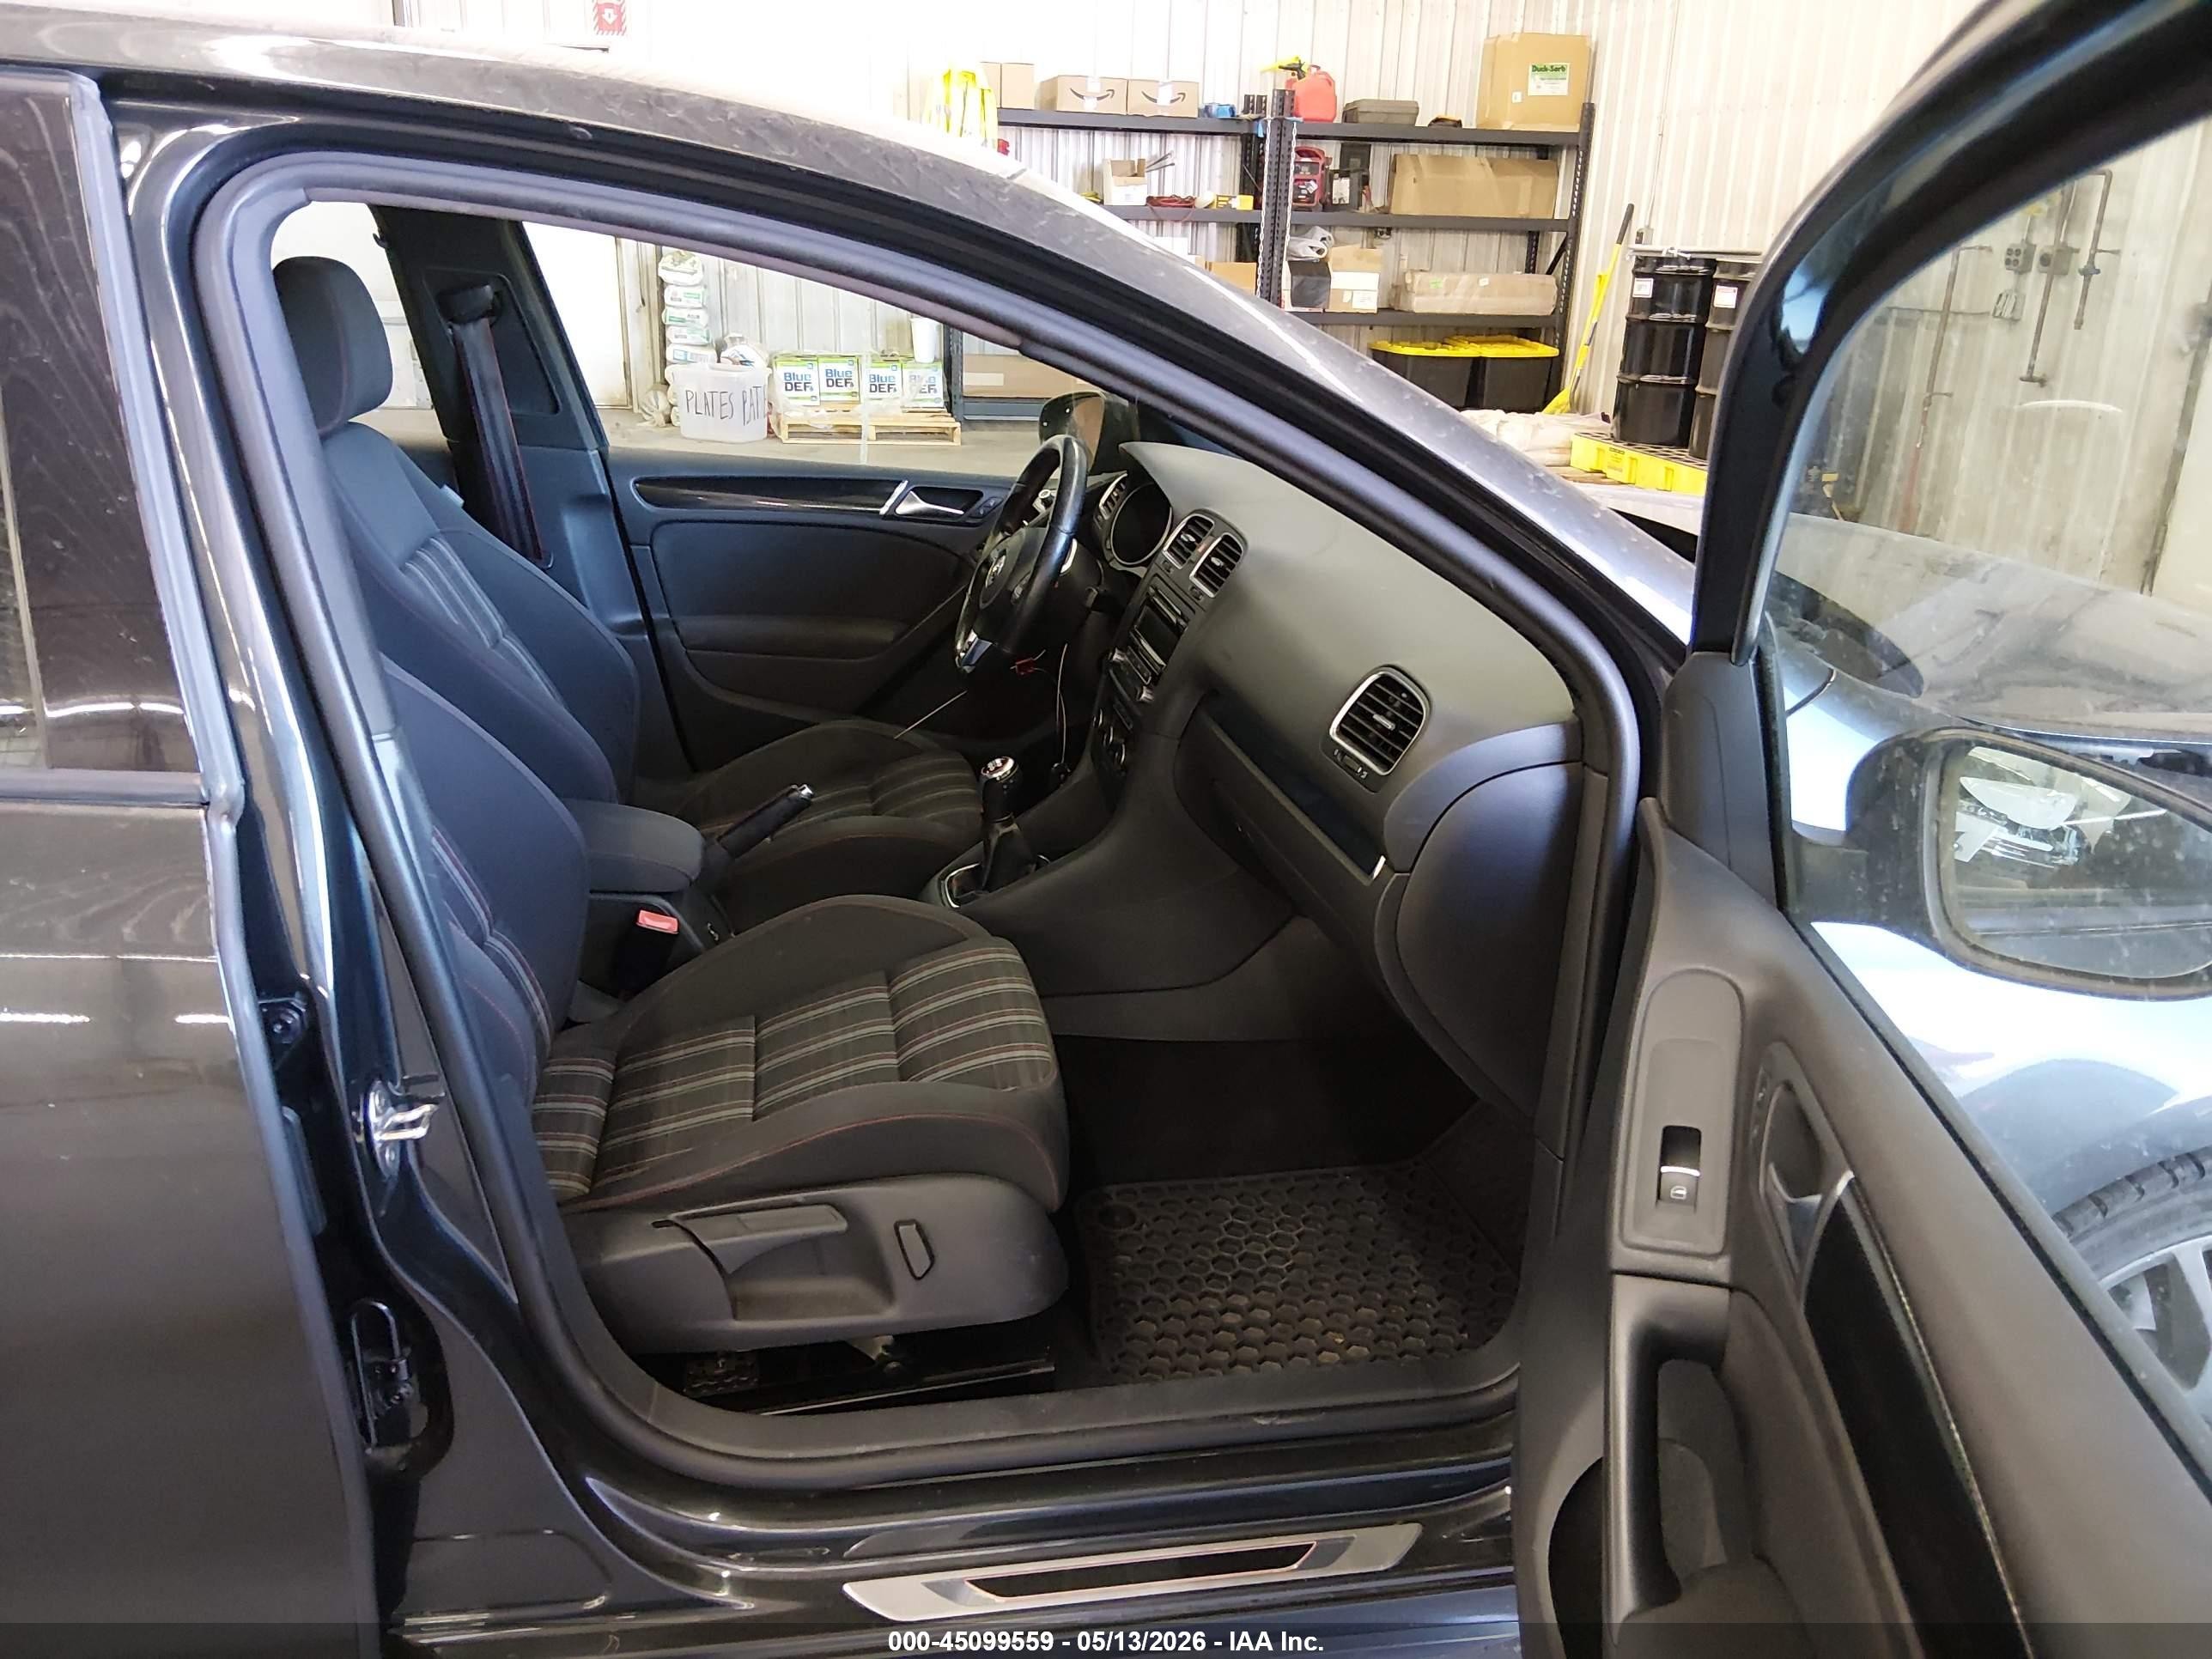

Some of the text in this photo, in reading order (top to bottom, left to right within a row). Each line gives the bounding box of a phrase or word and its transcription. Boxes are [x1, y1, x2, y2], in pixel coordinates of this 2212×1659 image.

[783, 372, 811, 381] Blue
[825, 368, 853, 378] Blue
[826, 378, 853, 387] DEF
[869, 374, 896, 383] Blue
[785, 382, 811, 392] DEF
[869, 383, 896, 392] DEF
[685, 390, 734, 420] PLATES
